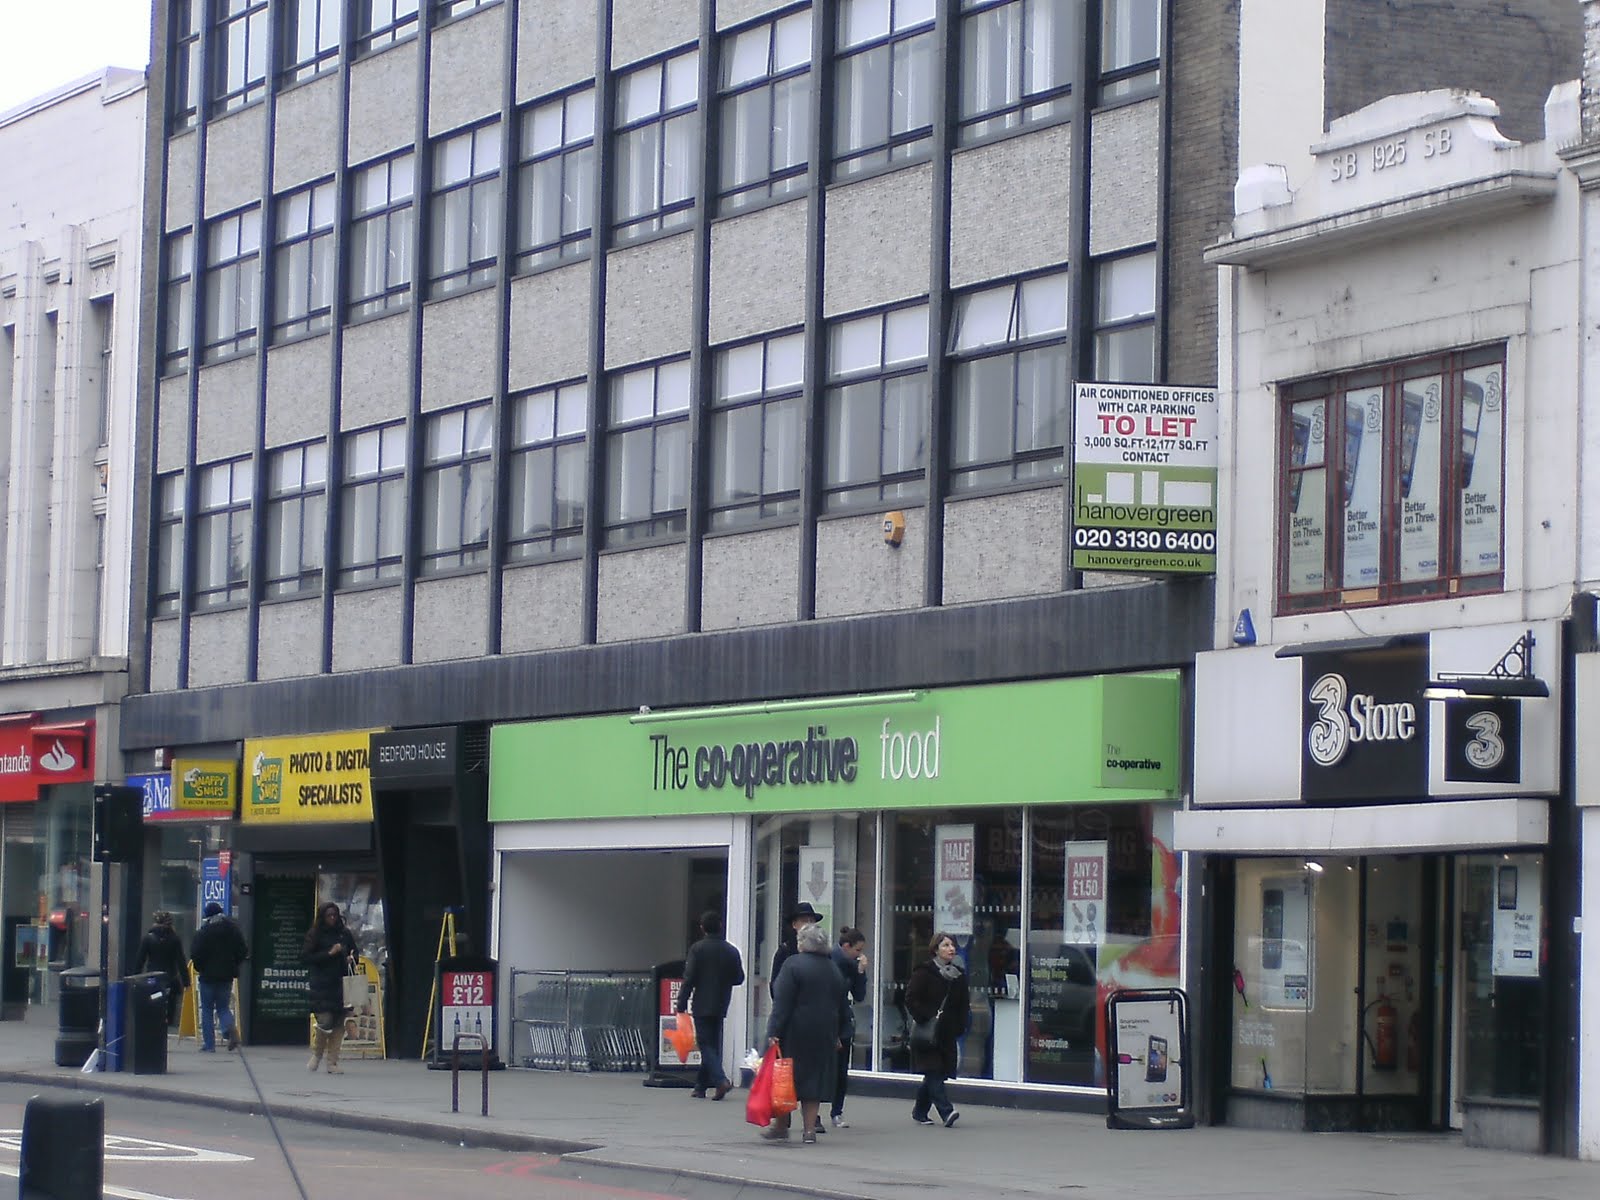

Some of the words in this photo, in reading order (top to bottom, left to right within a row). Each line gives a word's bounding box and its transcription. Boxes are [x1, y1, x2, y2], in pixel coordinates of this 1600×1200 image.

[1372, 139, 1406, 172] 1925
[1080, 388, 1097, 398] AIR
[1100, 388, 1169, 401] CONDITIONED
[1172, 391, 1214, 402] OFFICES
[1098, 402, 1123, 413] WITH
[1127, 403, 1147, 414] CAR
[1150, 404, 1196, 415] PARKING
[1097, 415, 1135, 435] TO
[1145, 416, 1197, 437] LET
[1085, 436, 1111, 449] 3,000
[1179, 440, 1208, 451] SQ.FT
[1122, 451, 1170, 463] CONTACT
[1078, 485, 1213, 526] hanovergreen
[1465, 493, 1487, 504] Better
[1405, 502, 1426, 512] Better
[1465, 507, 1473, 516] on
[1475, 504, 1497, 515] Three.
[1293, 517, 1313, 527] Better
[1347, 511, 1368, 521] Better
[1405, 516, 1413, 524] on
[1415, 513, 1436, 523] Three.
[1303, 527, 1322, 537] Three.
[1347, 524, 1356, 533] on
[1357, 521, 1378, 532] Three.
[1075, 528, 1111, 547] 020
[1115, 530, 1161, 549] 3130
[1165, 531, 1214, 550] 6400
[1087, 554, 1201, 567] hanovergreen.co.uk
[1309, 673, 1349, 767] 3
[1350, 694, 1416, 743] Store
[1465, 710, 1505, 769] 3
[380, 745, 416, 762] BEDFORD
[418, 742, 446, 760] HOUSE
[650, 735, 688, 790] The
[695, 724, 859, 800] co-operative
[880, 715, 940, 780] food
[290, 752, 323, 774] PHOTO
[325, 751, 332, 772] &
[336, 748, 369, 771] DIGITA
[1107, 758, 1161, 771] co-operative
[190, 775, 226, 788] SNAPPY
[154, 777, 171, 809] Na
[195, 786, 224, 797] SNAPS
[298, 782, 362, 806] SPECIALISTS
[944, 841, 970, 861] HALF
[944, 861, 970, 880] PRICE
[1073, 862, 1091, 877] ANY
[1092, 862, 1098, 877] 2
[205, 880, 225, 900] CASH
[1072, 880, 1098, 896] £1.50
[263, 967, 309, 978] Banner
[261, 979, 310, 991] Printing
[453, 975, 474, 986] ANY
[477, 975, 483, 986] 3
[670, 982, 682, 990] BU
[453, 986, 484, 1005] £12
